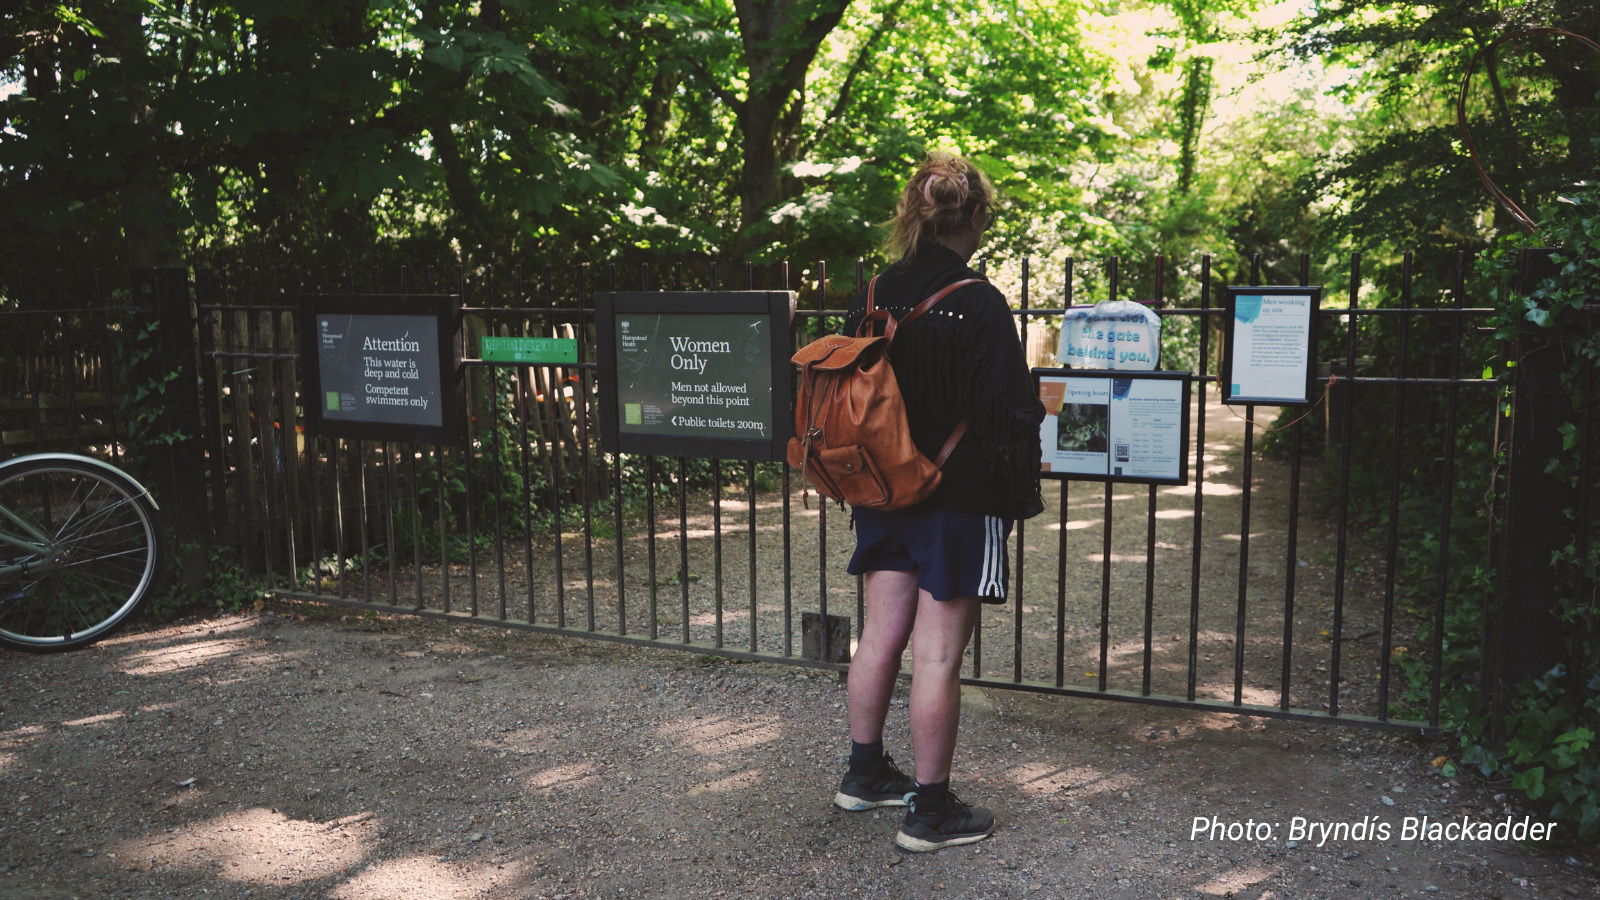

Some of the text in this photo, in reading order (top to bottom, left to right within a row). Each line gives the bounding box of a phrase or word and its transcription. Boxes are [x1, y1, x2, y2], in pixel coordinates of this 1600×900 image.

[1278, 299, 1306, 307] working
[622, 335, 648, 343] Hampstead
[1107, 330, 1140, 343] gate
[362, 336, 421, 352] Attention
[485, 338, 499, 351] KEEP
[500, 339, 519, 351] CLEAR
[519, 339, 551, 352] EMERGENCY
[669, 336, 731, 353] Women
[1067, 342, 1151, 363] behind you.
[363, 356, 416, 369] This water is
[670, 354, 708, 375] Only
[364, 367, 419, 381] deep and cold
[365, 383, 410, 397] Competent
[671, 382, 747, 394] Men not allowed
[1066, 389, 1092, 398] Opening
[1092, 389, 1109, 397] hours
[365, 395, 409, 407] swimmers
[410, 396, 428, 410] only
[671, 394, 750, 409] beyond this point
[678, 416, 764, 430] Public toilets 200m
